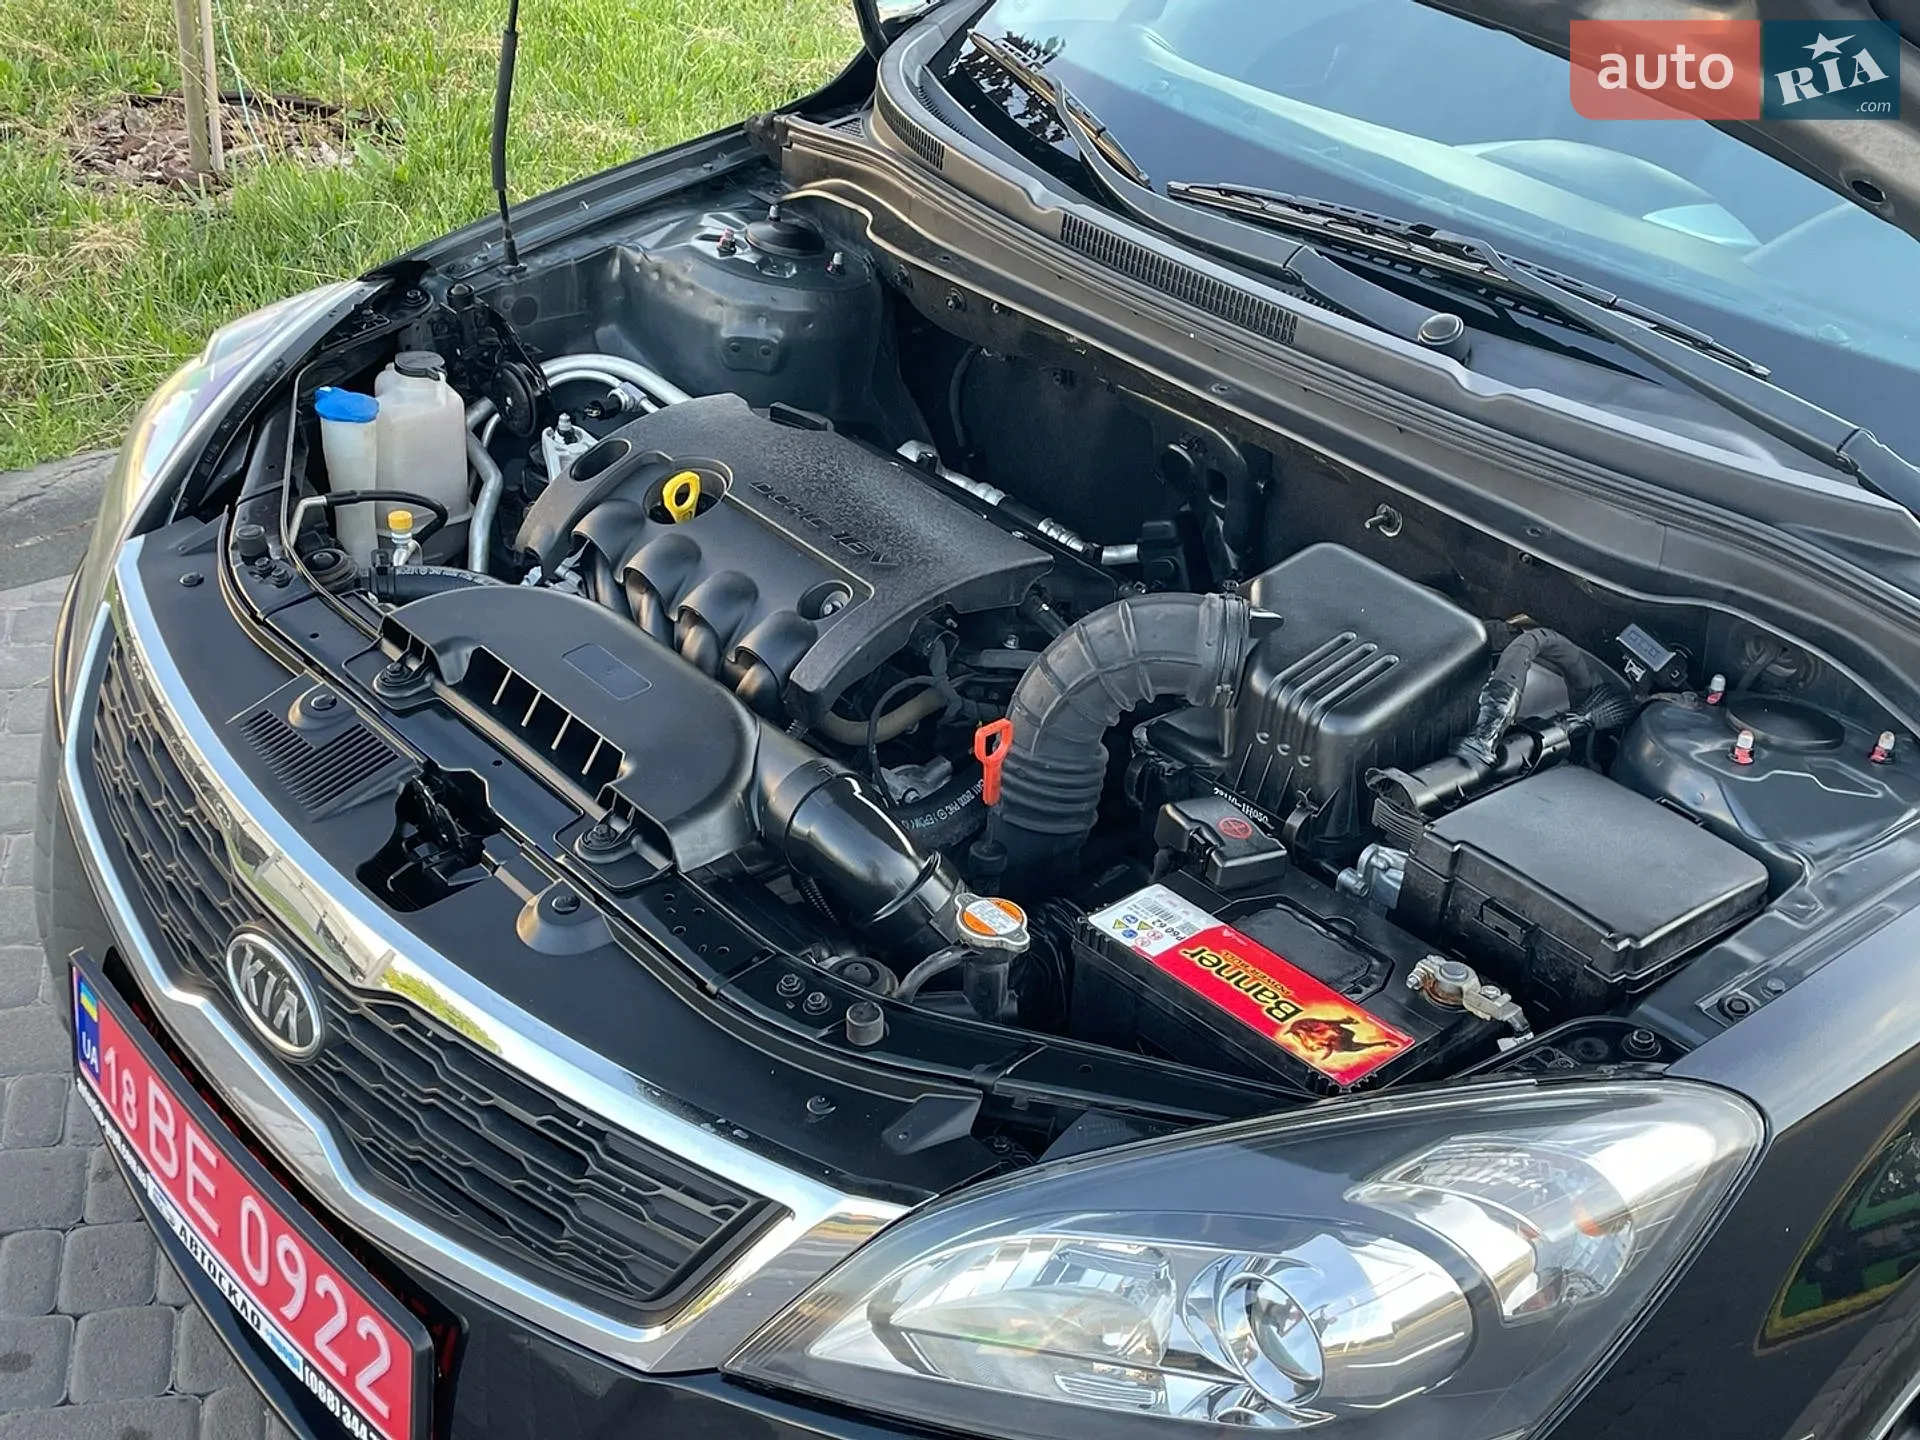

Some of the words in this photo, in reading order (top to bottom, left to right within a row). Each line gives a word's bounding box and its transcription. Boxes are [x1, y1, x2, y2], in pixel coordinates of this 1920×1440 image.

[1180, 946, 1305, 1023] Banner
[1223, 950, 1251, 971] BULL
[1249, 967, 1292, 996] POWER
[240, 943, 298, 1046] KIA
[81, 1031, 99, 1074] UA
[104, 1046, 139, 1131] 18
[147, 1075, 222, 1238] BE
[240, 1194, 391, 1421] 0922
